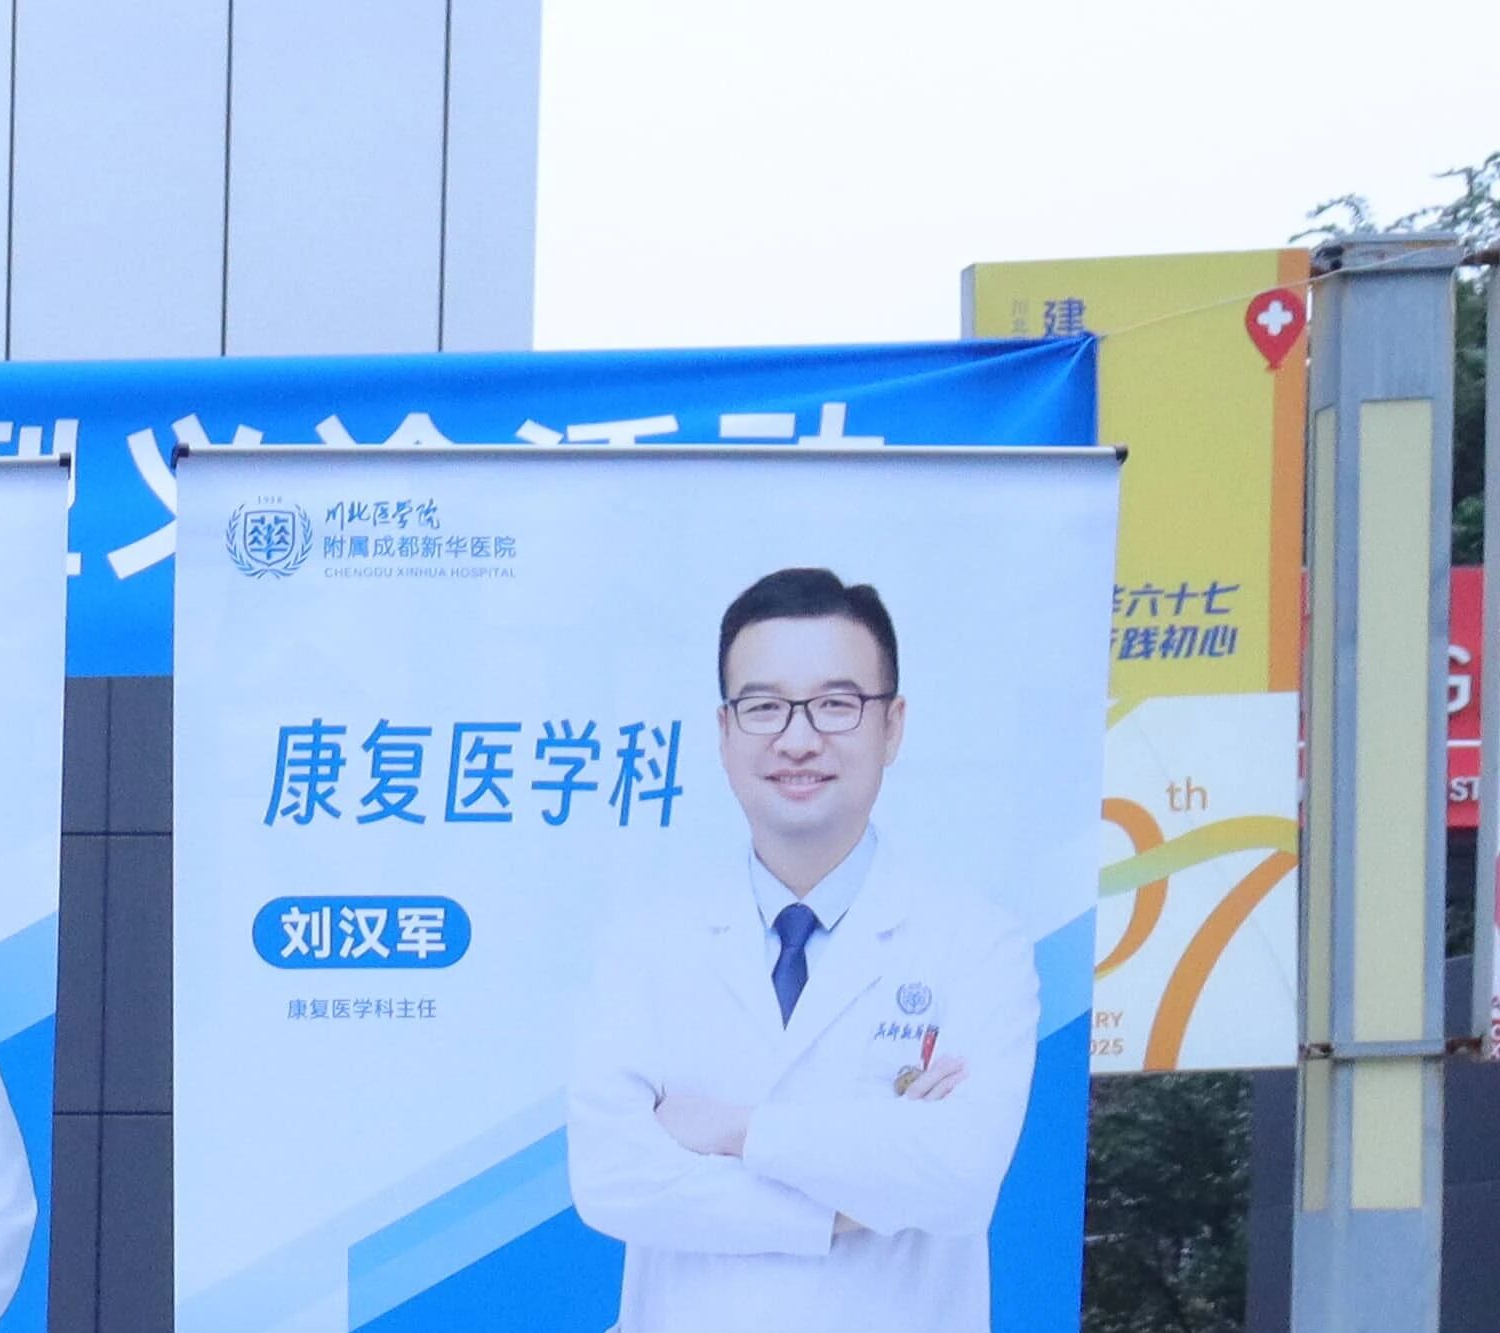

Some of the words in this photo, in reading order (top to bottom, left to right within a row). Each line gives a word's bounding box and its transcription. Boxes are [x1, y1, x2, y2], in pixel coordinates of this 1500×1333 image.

[323, 535, 516, 559] 附属成都新华医院
[262, 719, 684, 829] 康复医学科
[1165, 776, 1208, 812] th
[280, 905, 447, 959] 刘汉军
[287, 997, 438, 1021] 康复医学科主任
[1093, 1012, 1124, 1028] RY
